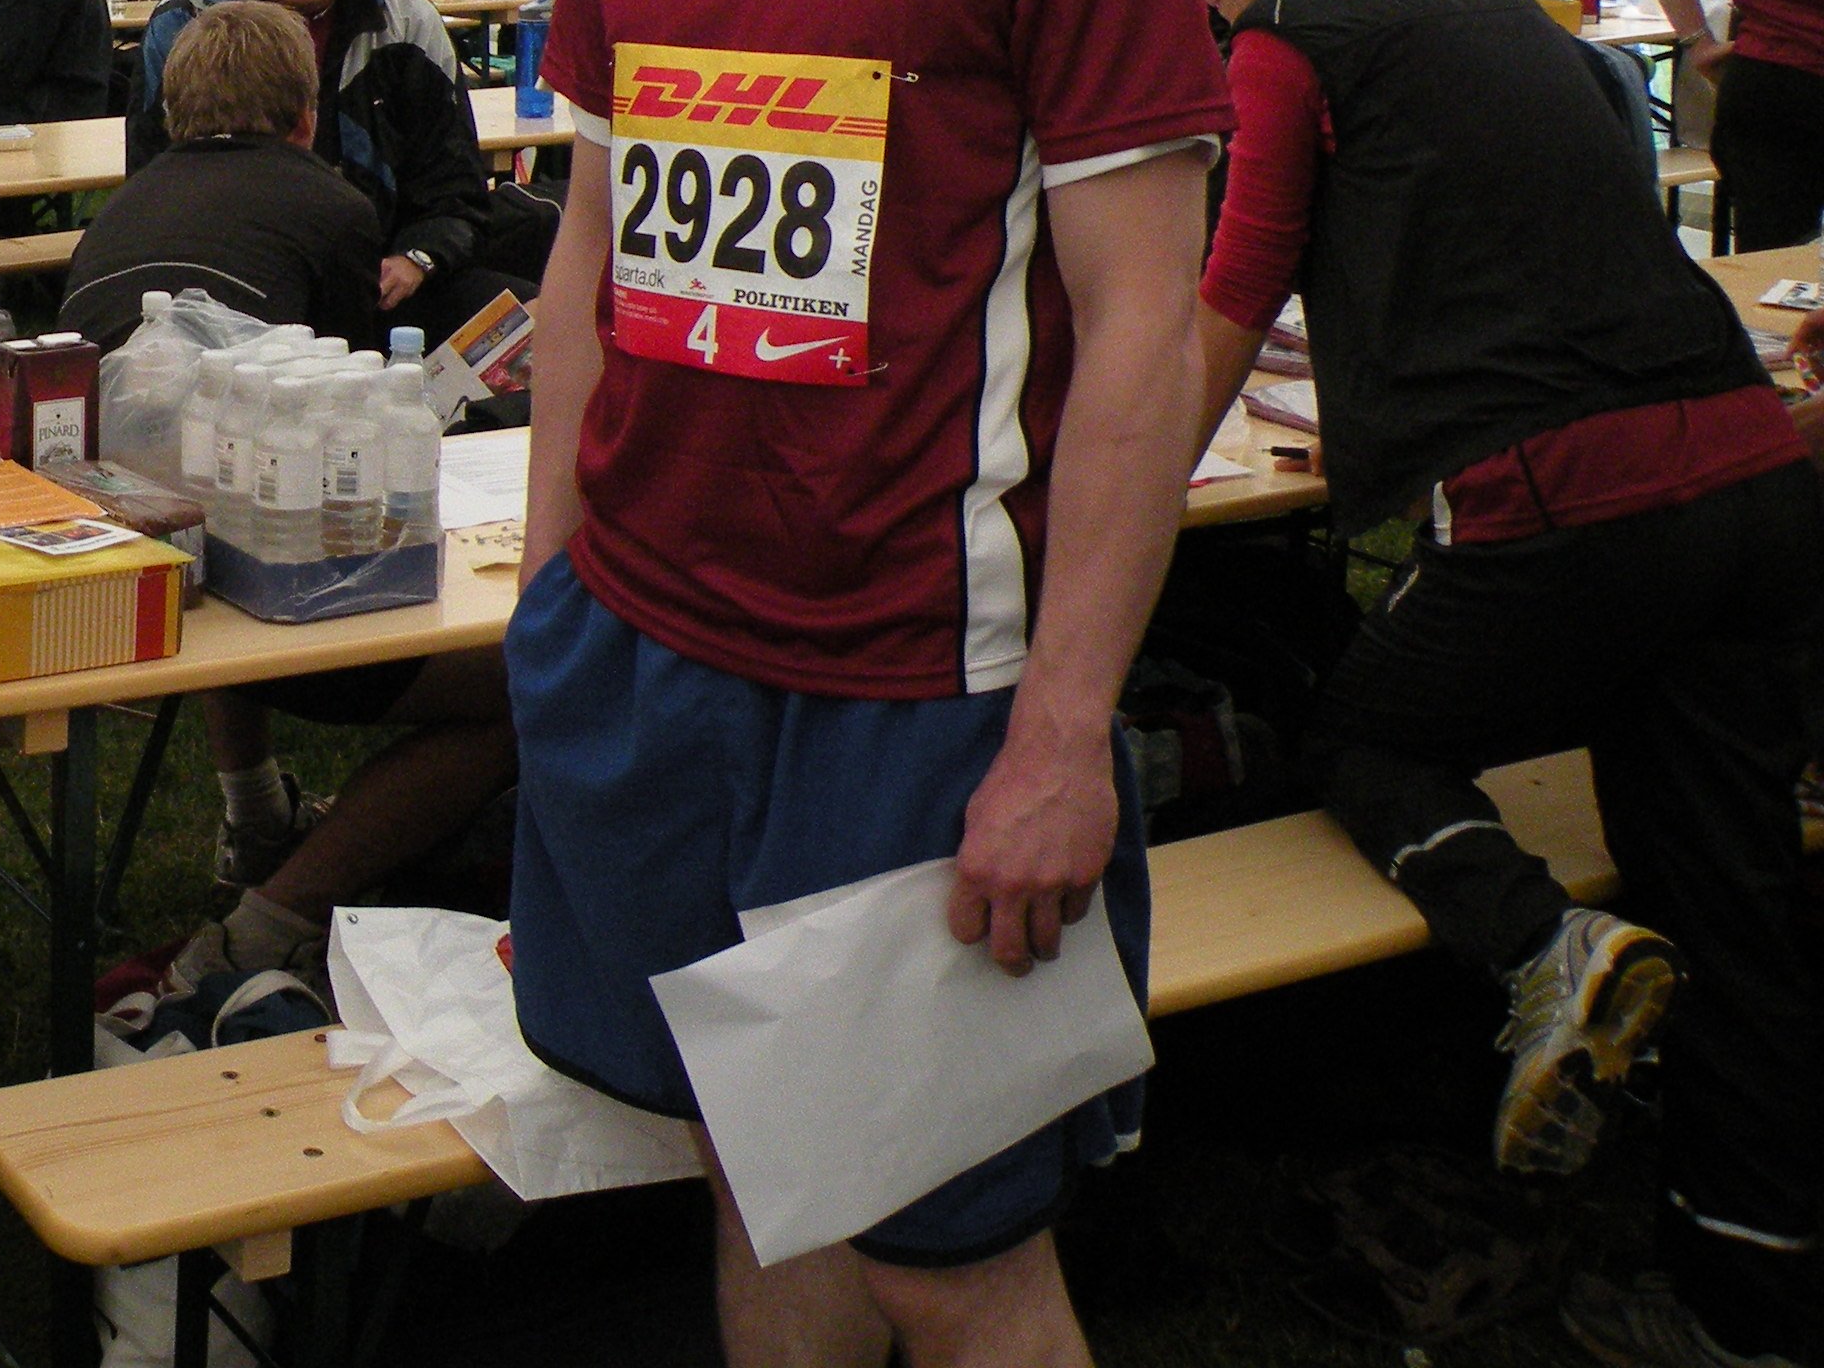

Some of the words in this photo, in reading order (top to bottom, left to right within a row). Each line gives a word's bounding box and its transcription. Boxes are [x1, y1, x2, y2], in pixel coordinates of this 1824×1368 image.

[627, 66, 839, 133] DHL
[620, 143, 836, 280] 2928
[851, 180, 878, 277] MANDAG
[686, 303, 719, 365] 4
[734, 288, 850, 317] POLITIKEN
[38, 424, 80, 441] PINARD
